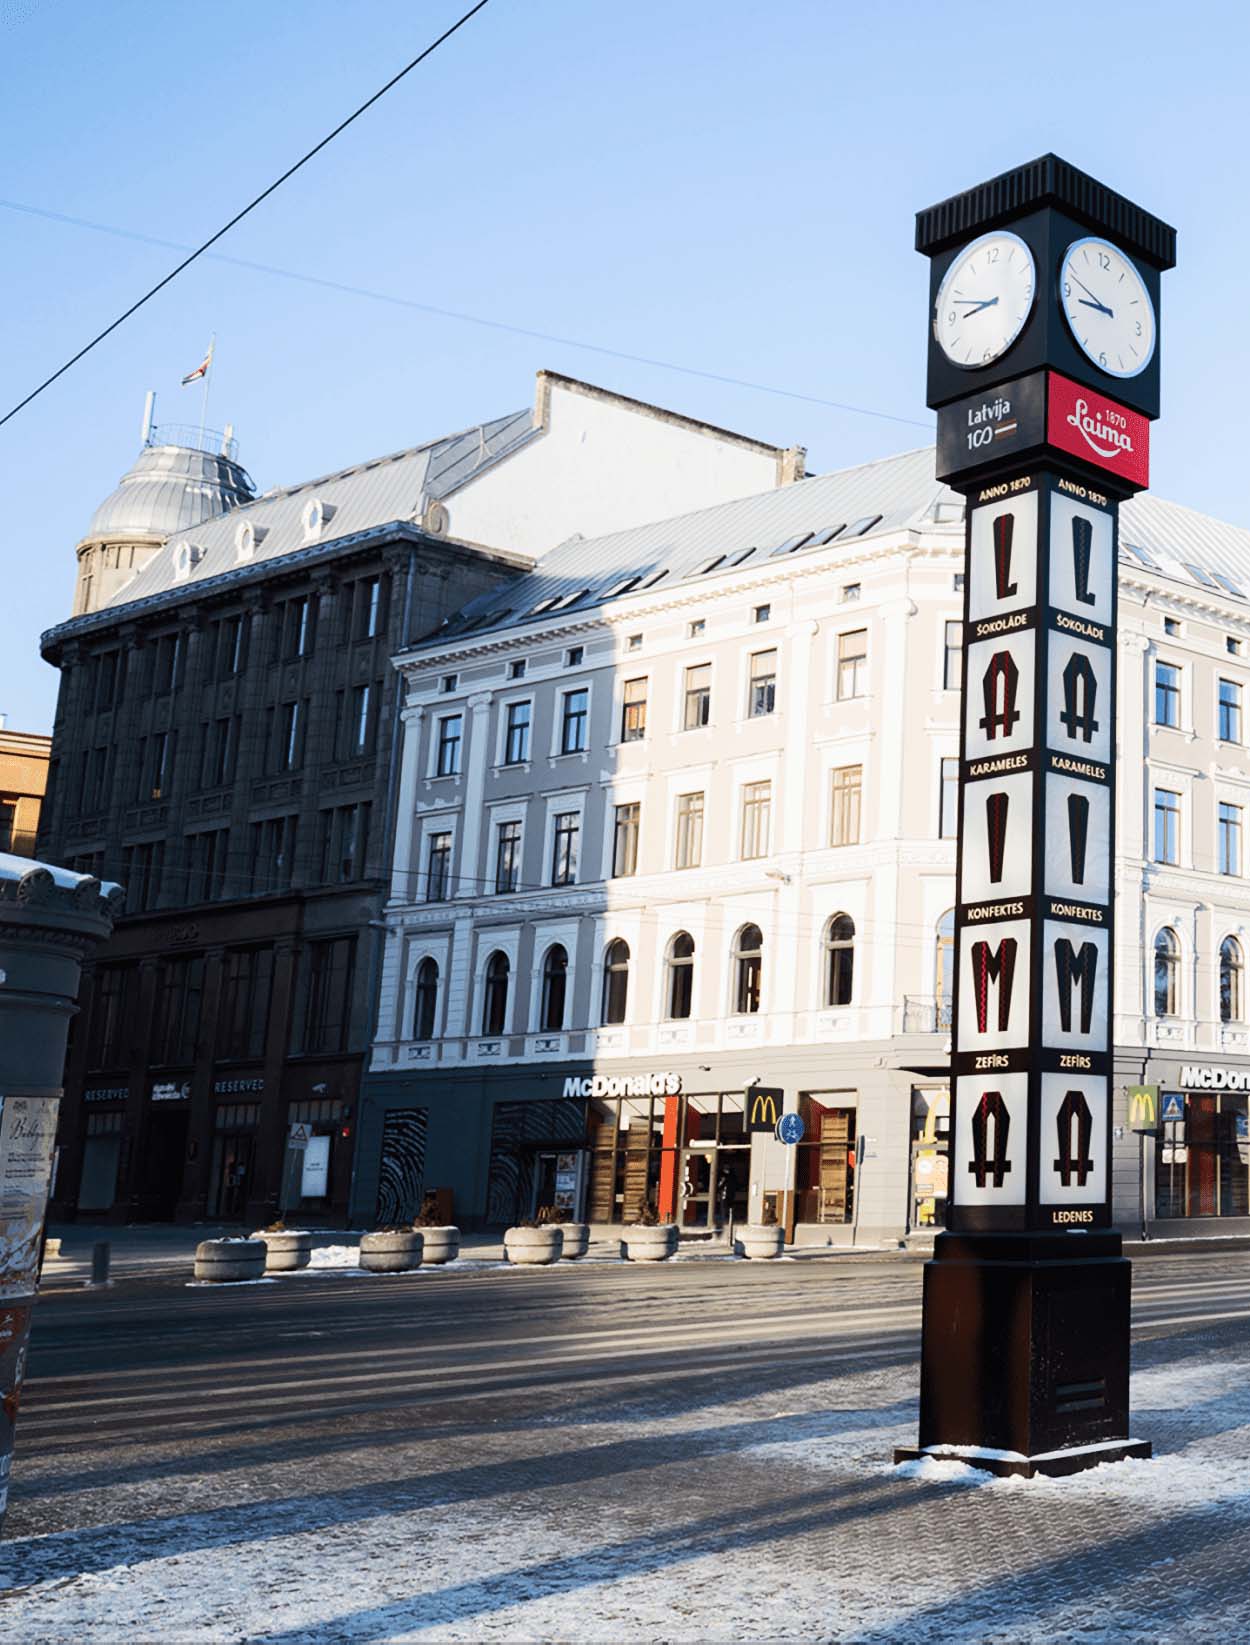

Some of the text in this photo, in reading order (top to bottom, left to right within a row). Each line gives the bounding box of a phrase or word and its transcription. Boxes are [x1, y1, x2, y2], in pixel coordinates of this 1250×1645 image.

[987, 247, 1000, 265] 12
[1098, 251, 1111, 272] 12
[948, 311, 957, 327] 9
[1134, 320, 1142, 337] 3
[1098, 351, 1108, 367] 6
[967, 398, 1011, 427] Latvija
[1105, 409, 1127, 429] 1870
[1066, 398, 1134, 458] Laima
[979, 476, 1031, 501] ANNO 1870
[1058, 478, 1086, 498] ANNO
[969, 754, 1028, 776] KARAMELES
[1051, 755, 1106, 780] KARAMELES
[967, 902, 1024, 921] KONFEKTES
[1050, 902, 1103, 922] KONFEKTES
[563, 1073, 682, 1098] McDonald's
[1053, 1211, 1093, 1223] LEDENES
